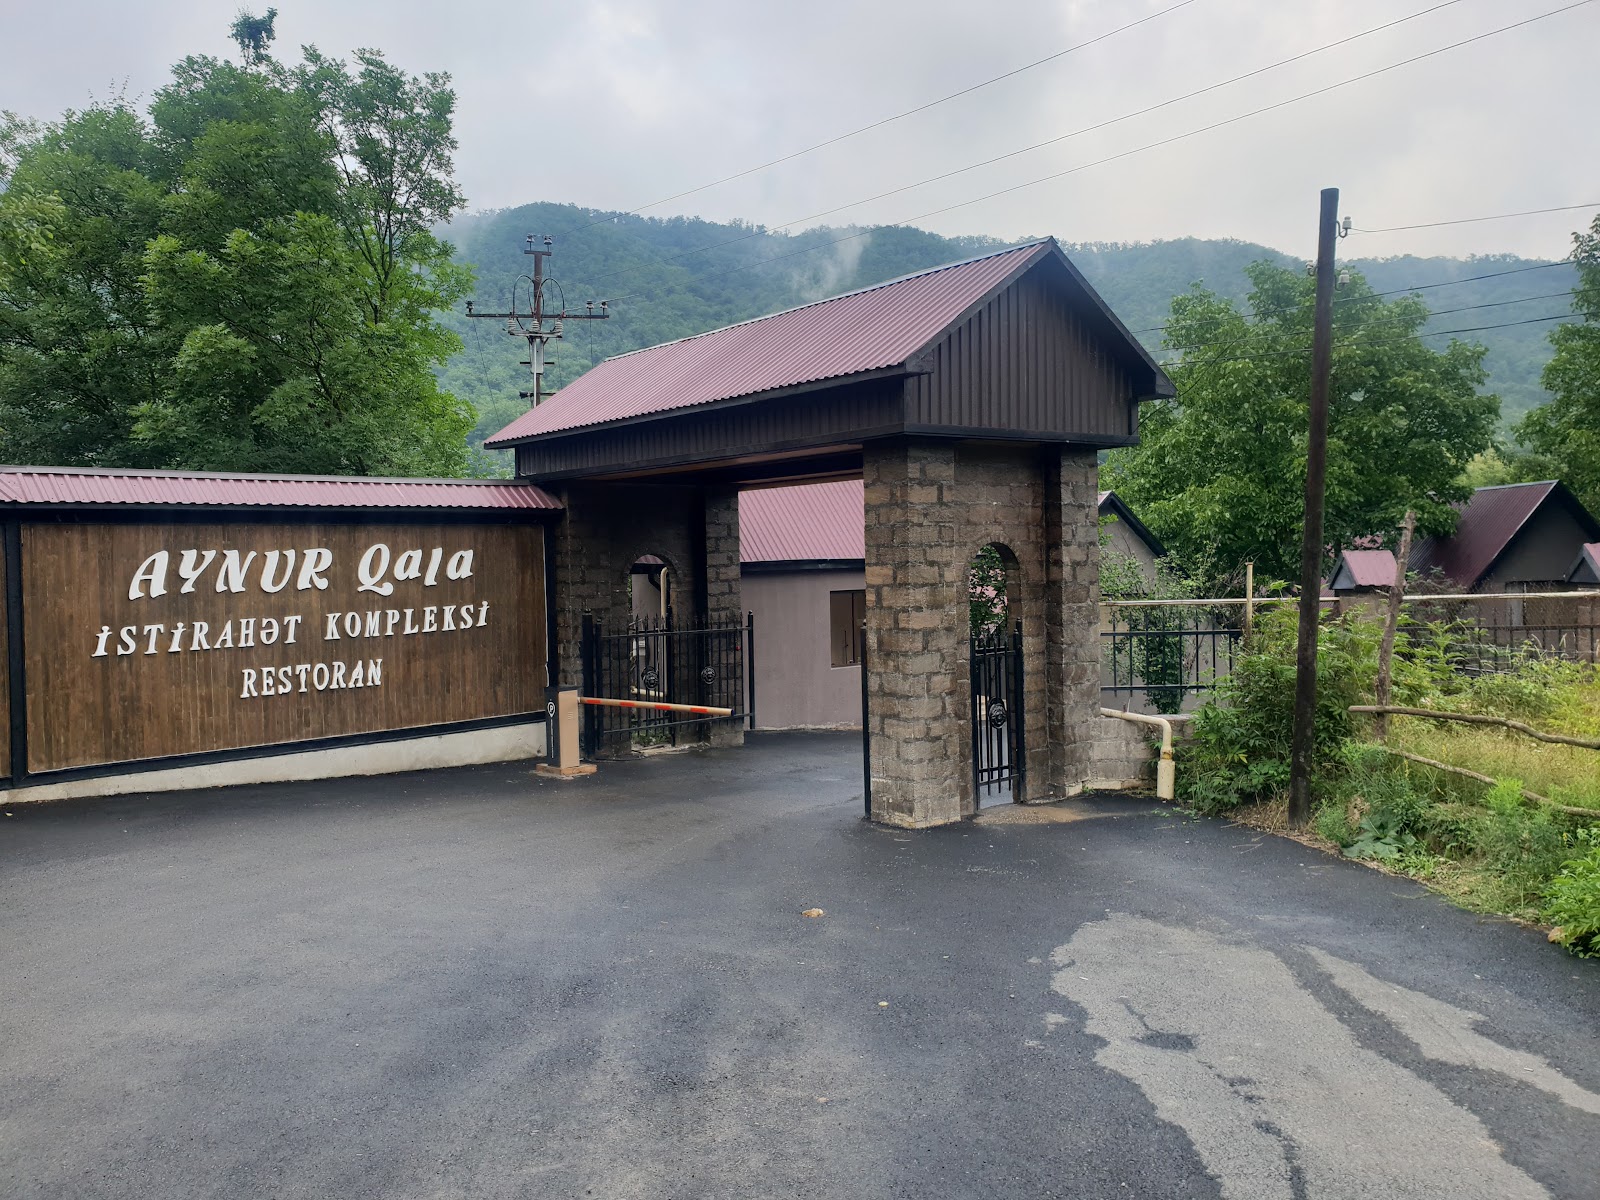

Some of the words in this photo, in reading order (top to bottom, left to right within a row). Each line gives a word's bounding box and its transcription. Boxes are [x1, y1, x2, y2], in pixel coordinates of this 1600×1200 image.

[128, 547, 333, 601] AYNUR
[356, 543, 474, 597] Qala
[91, 614, 302, 657] İSTİRAHƏT
[324, 600, 490, 641] KOMPLEKSİ
[240, 658, 383, 699] RESTORAN
